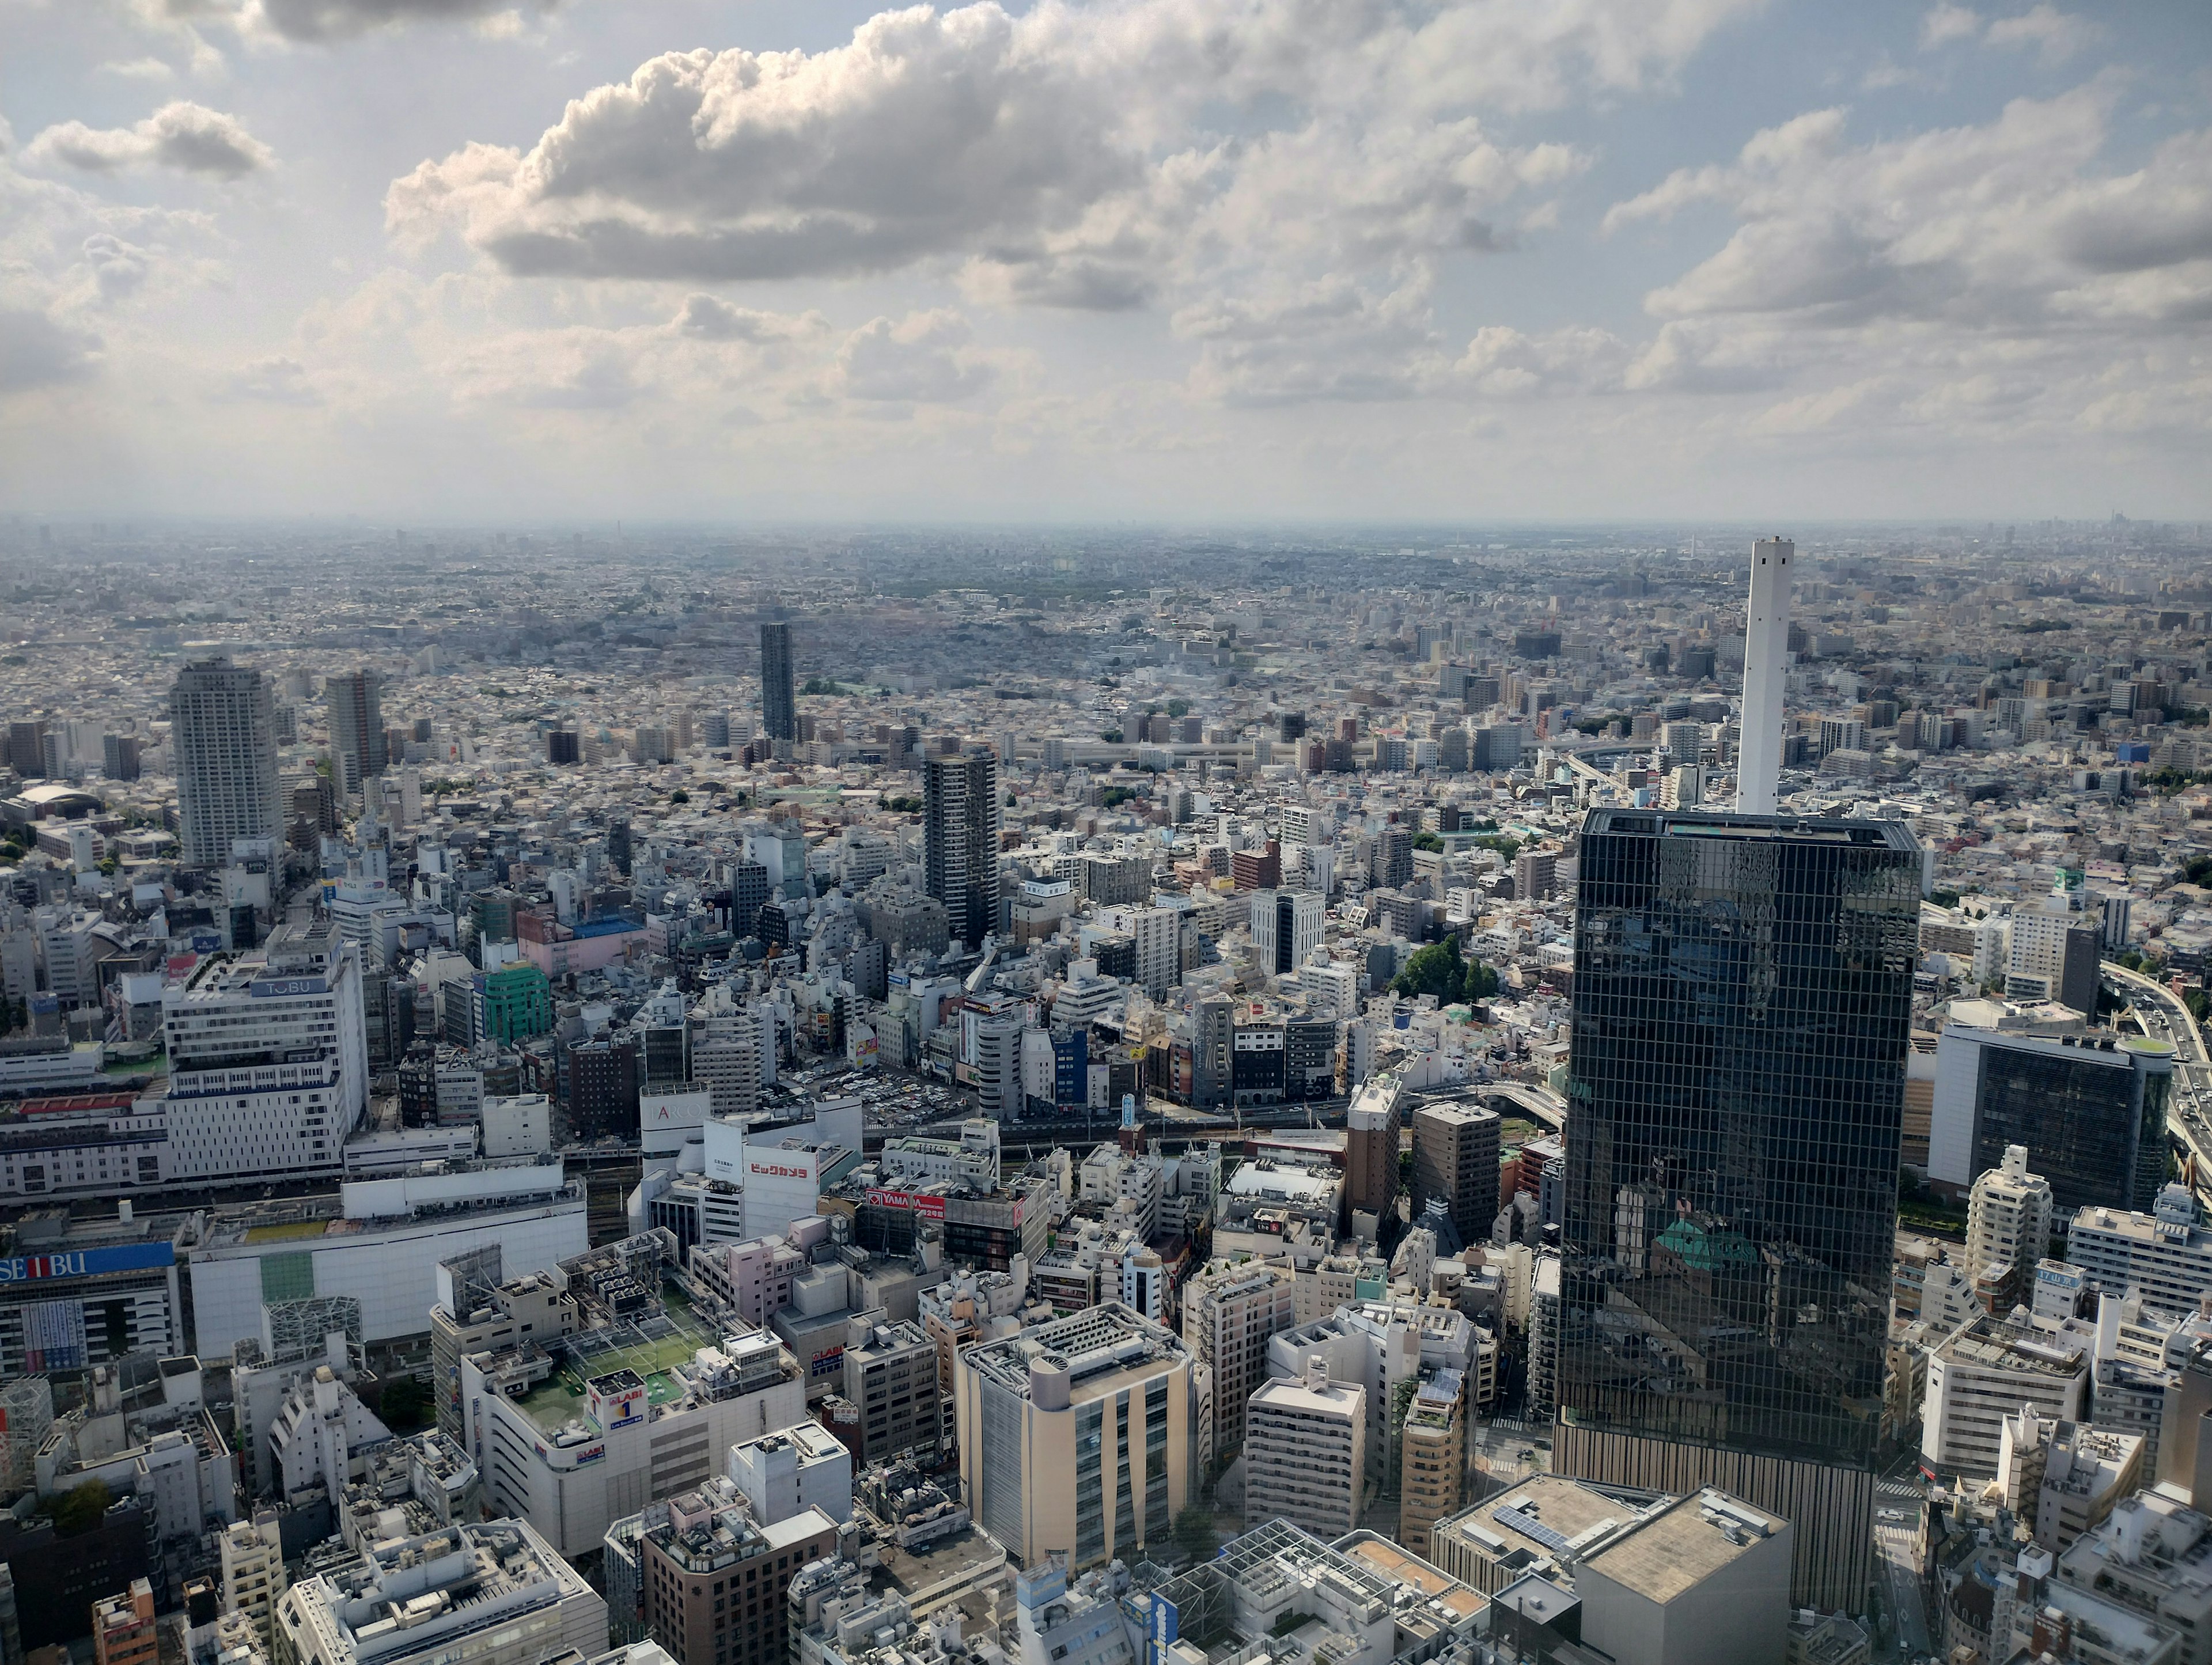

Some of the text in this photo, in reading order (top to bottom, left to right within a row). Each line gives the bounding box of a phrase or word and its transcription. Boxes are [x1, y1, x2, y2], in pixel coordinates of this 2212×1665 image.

[267, 981, 310, 994] TOBU
[651, 1103, 702, 1120] PARCO
[751, 1162, 807, 1178] ビックカメラ
[0, 1253, 86, 1281] SEIBU
[617, 1390, 642, 1404] LABI
